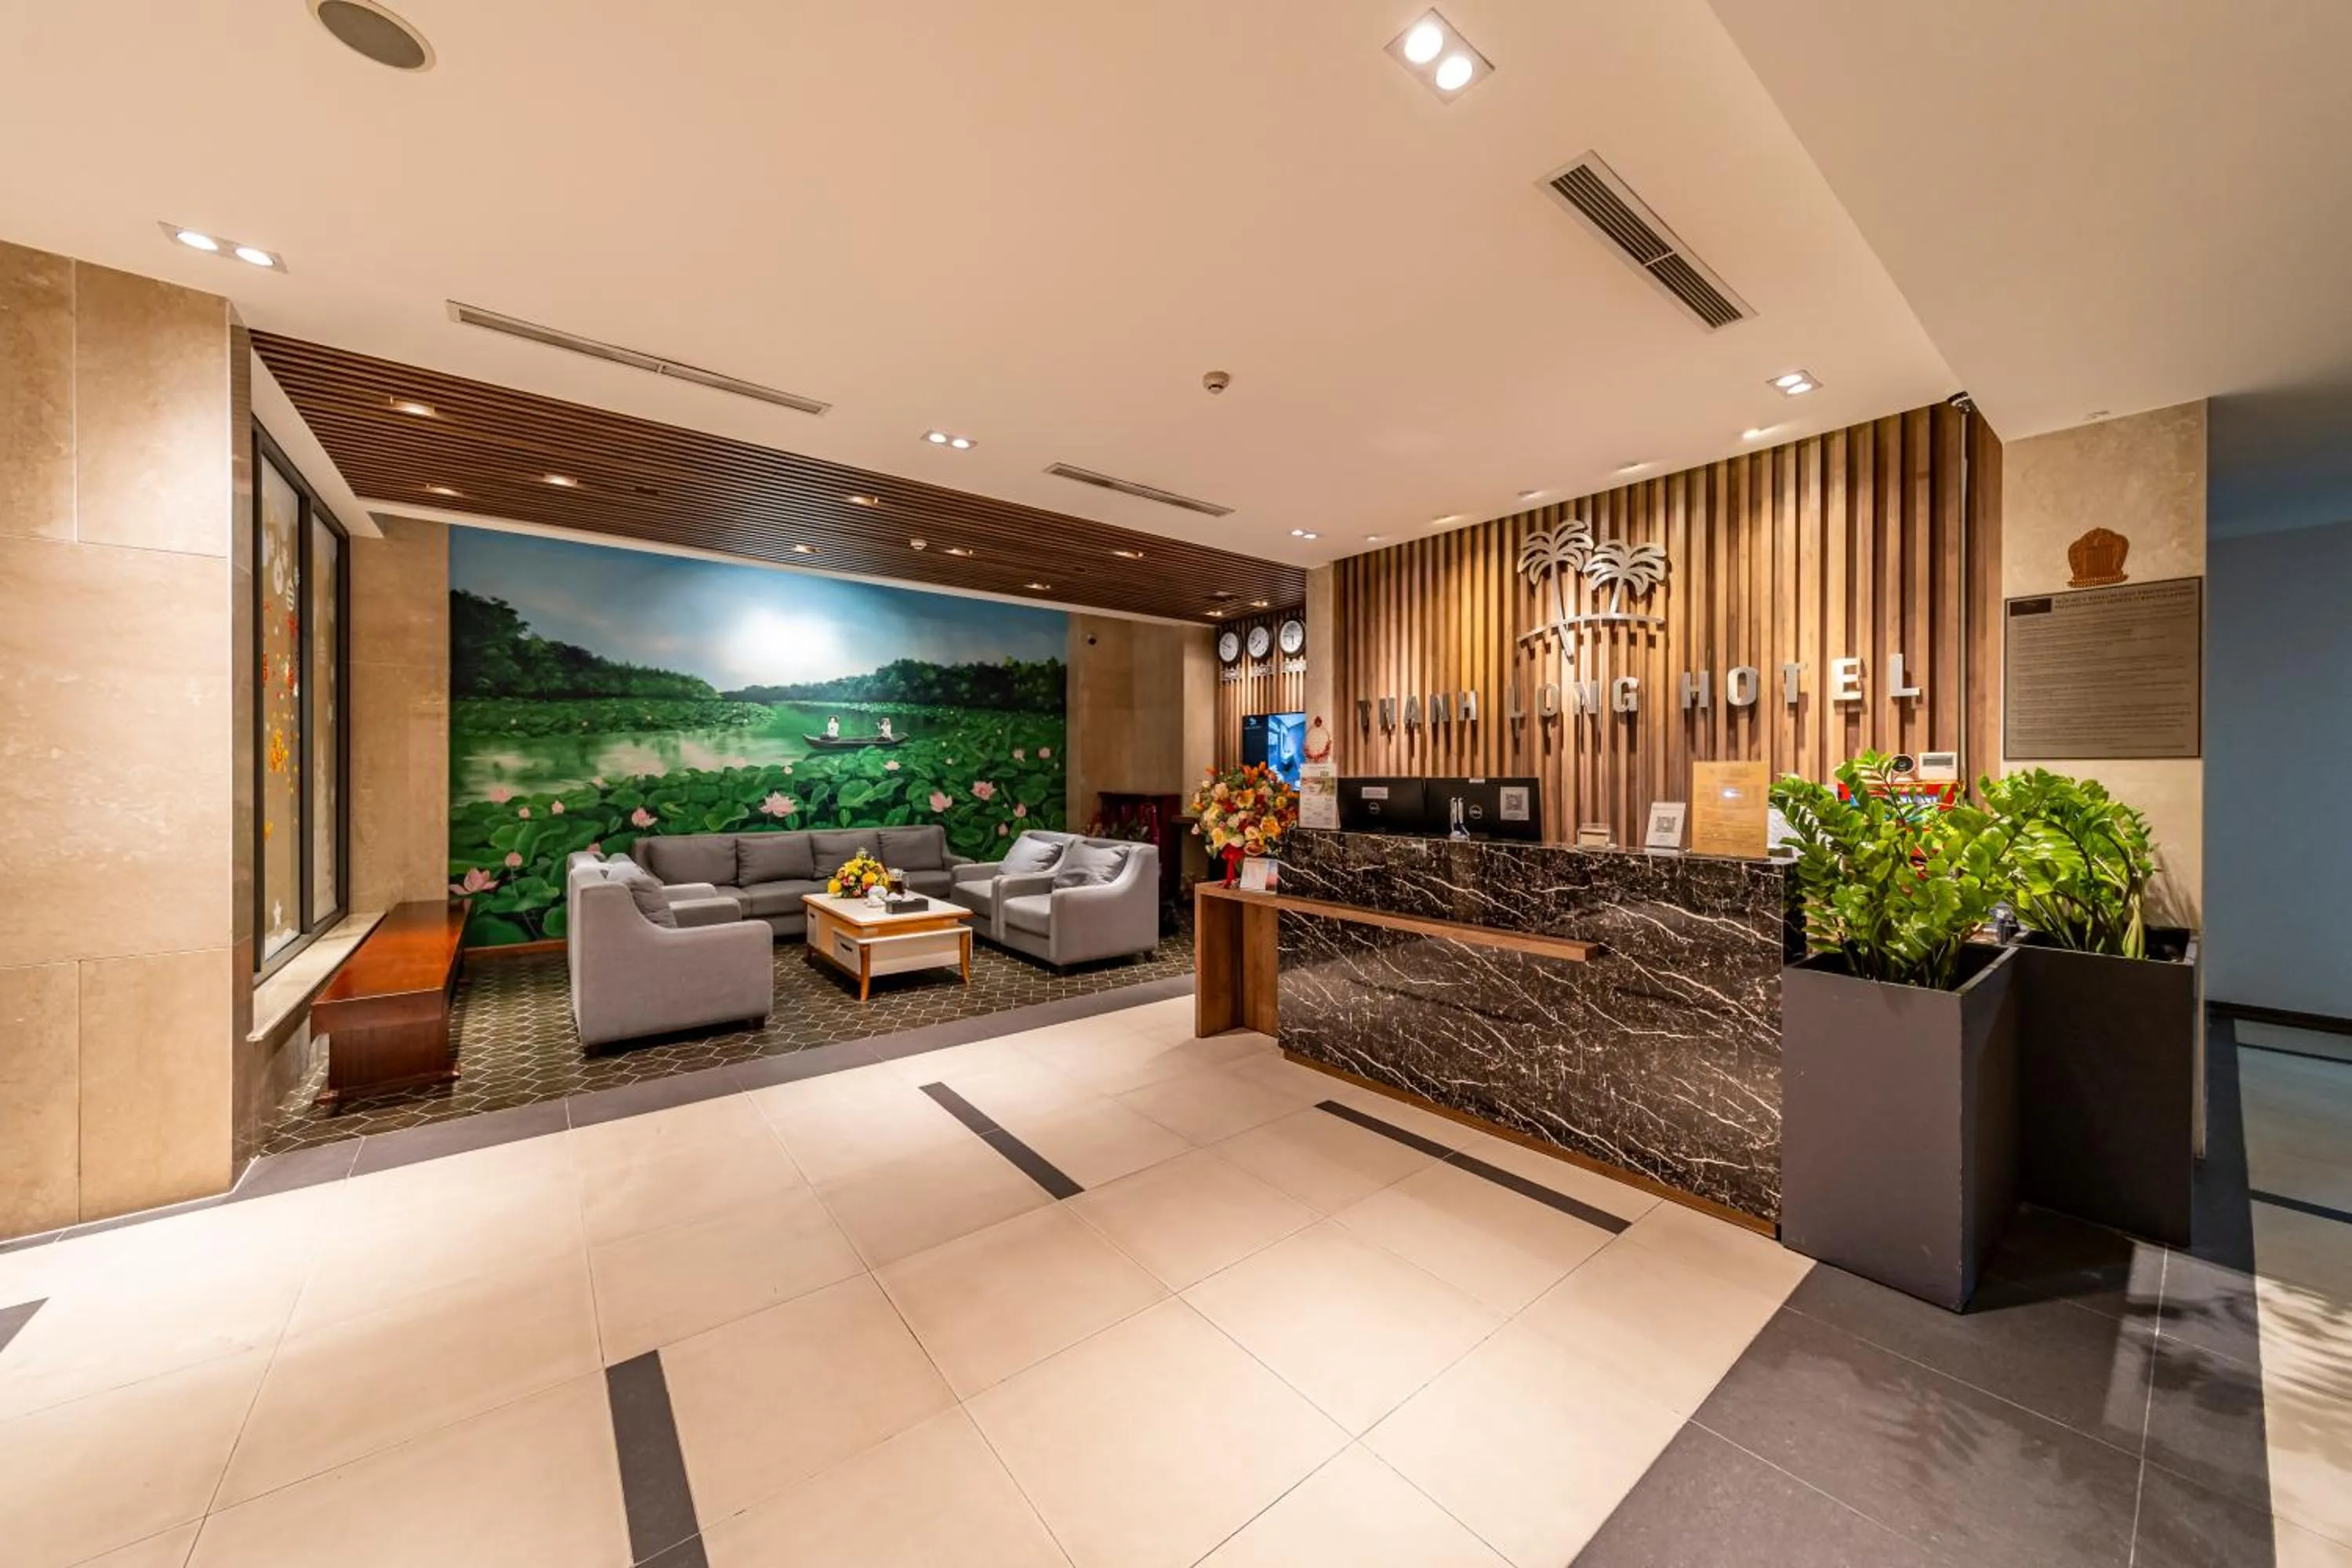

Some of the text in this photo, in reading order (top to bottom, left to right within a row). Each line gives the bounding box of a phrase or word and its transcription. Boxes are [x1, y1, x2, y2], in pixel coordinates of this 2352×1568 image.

[1357, 653, 1920, 728] THANH LONG HOTEL
